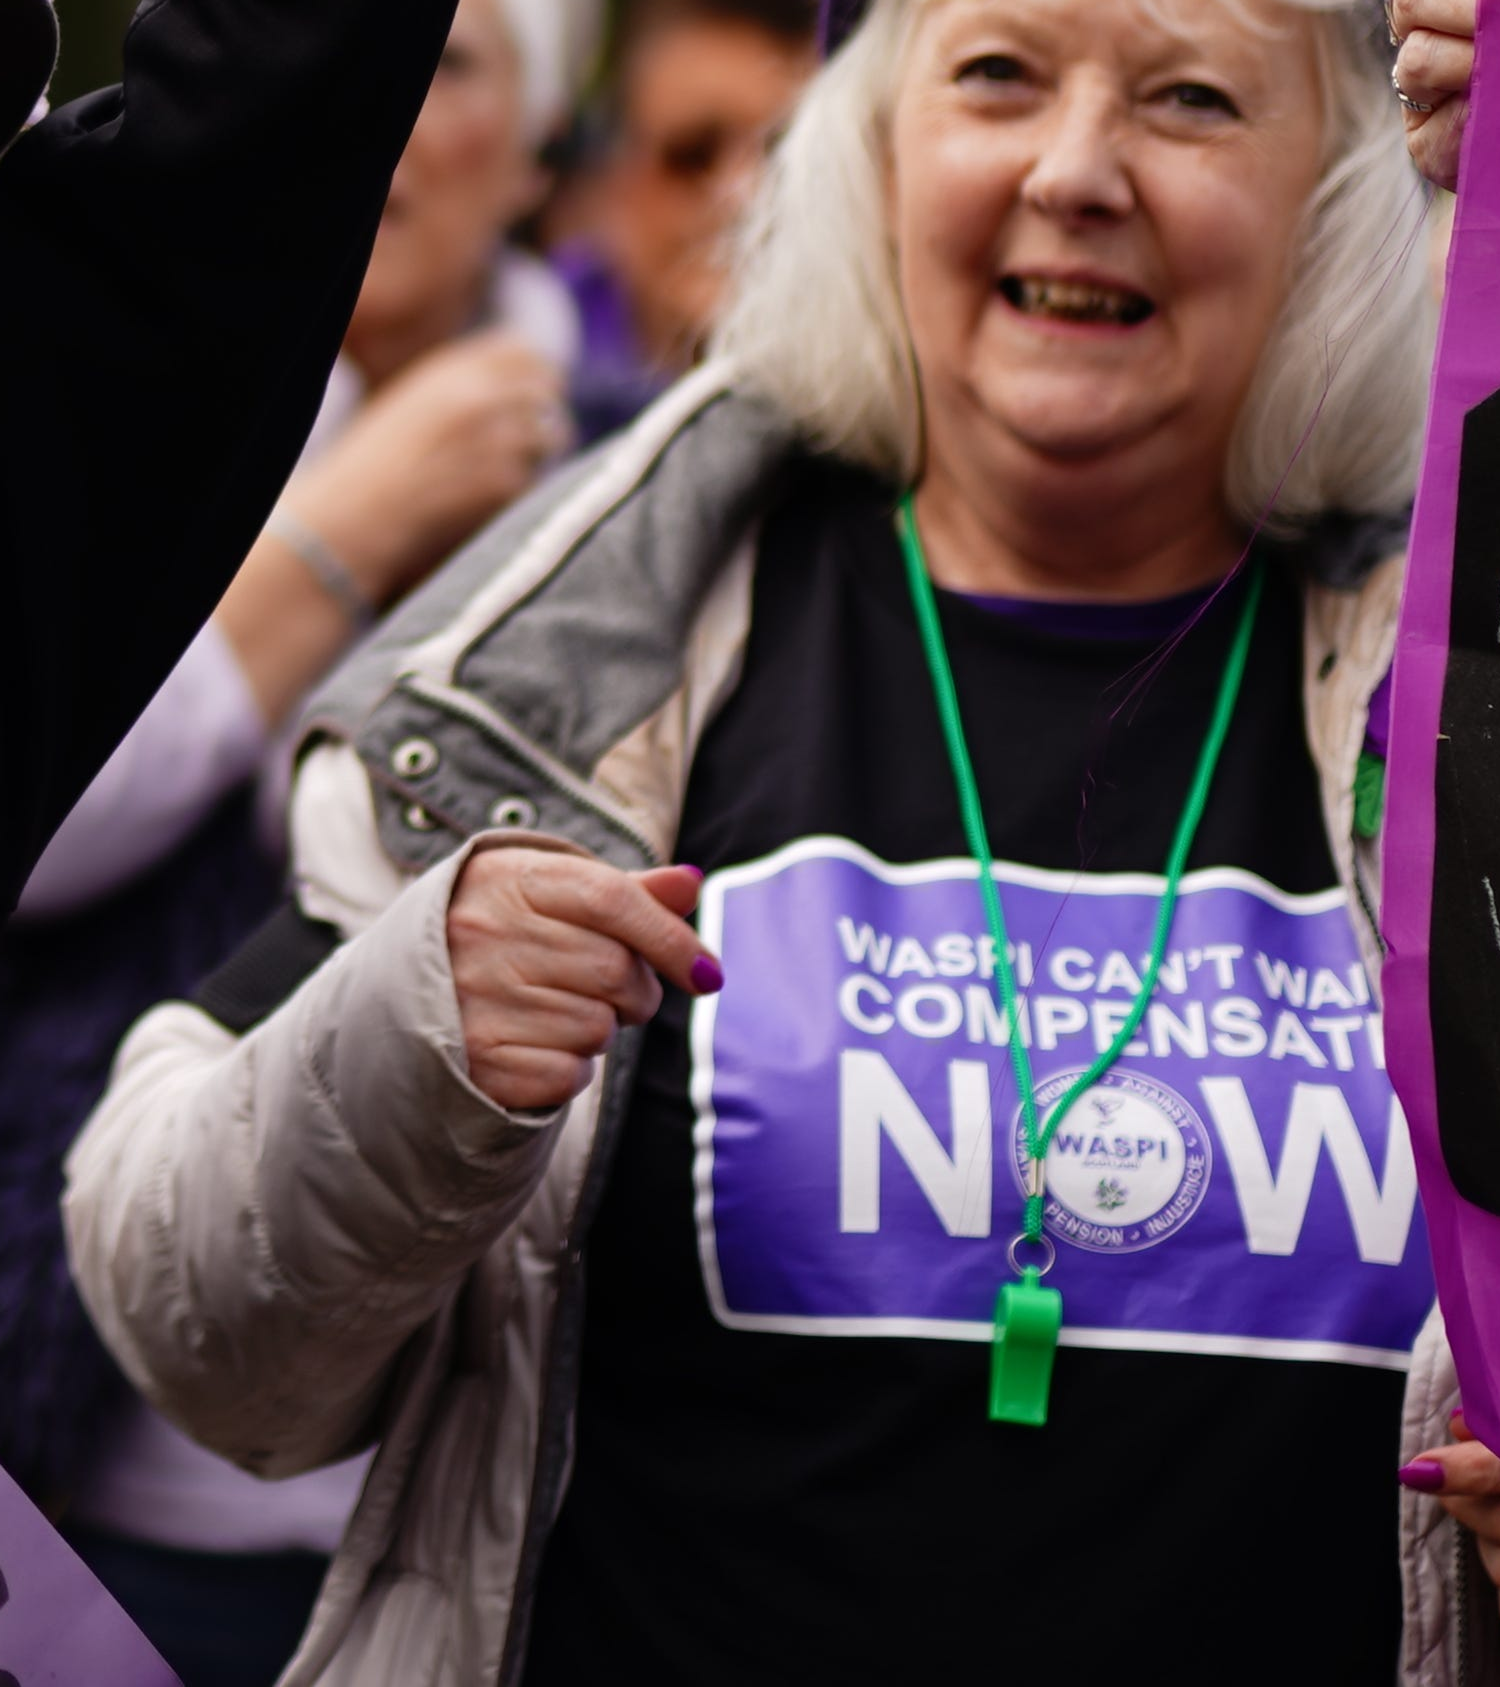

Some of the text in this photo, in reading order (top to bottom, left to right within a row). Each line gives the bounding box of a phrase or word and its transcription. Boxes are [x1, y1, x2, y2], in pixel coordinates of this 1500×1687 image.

[837, 915, 1033, 987] WASPI
[1050, 944, 1243, 996] CAN'T
[1056, 1134, 1169, 1161] WASPI
